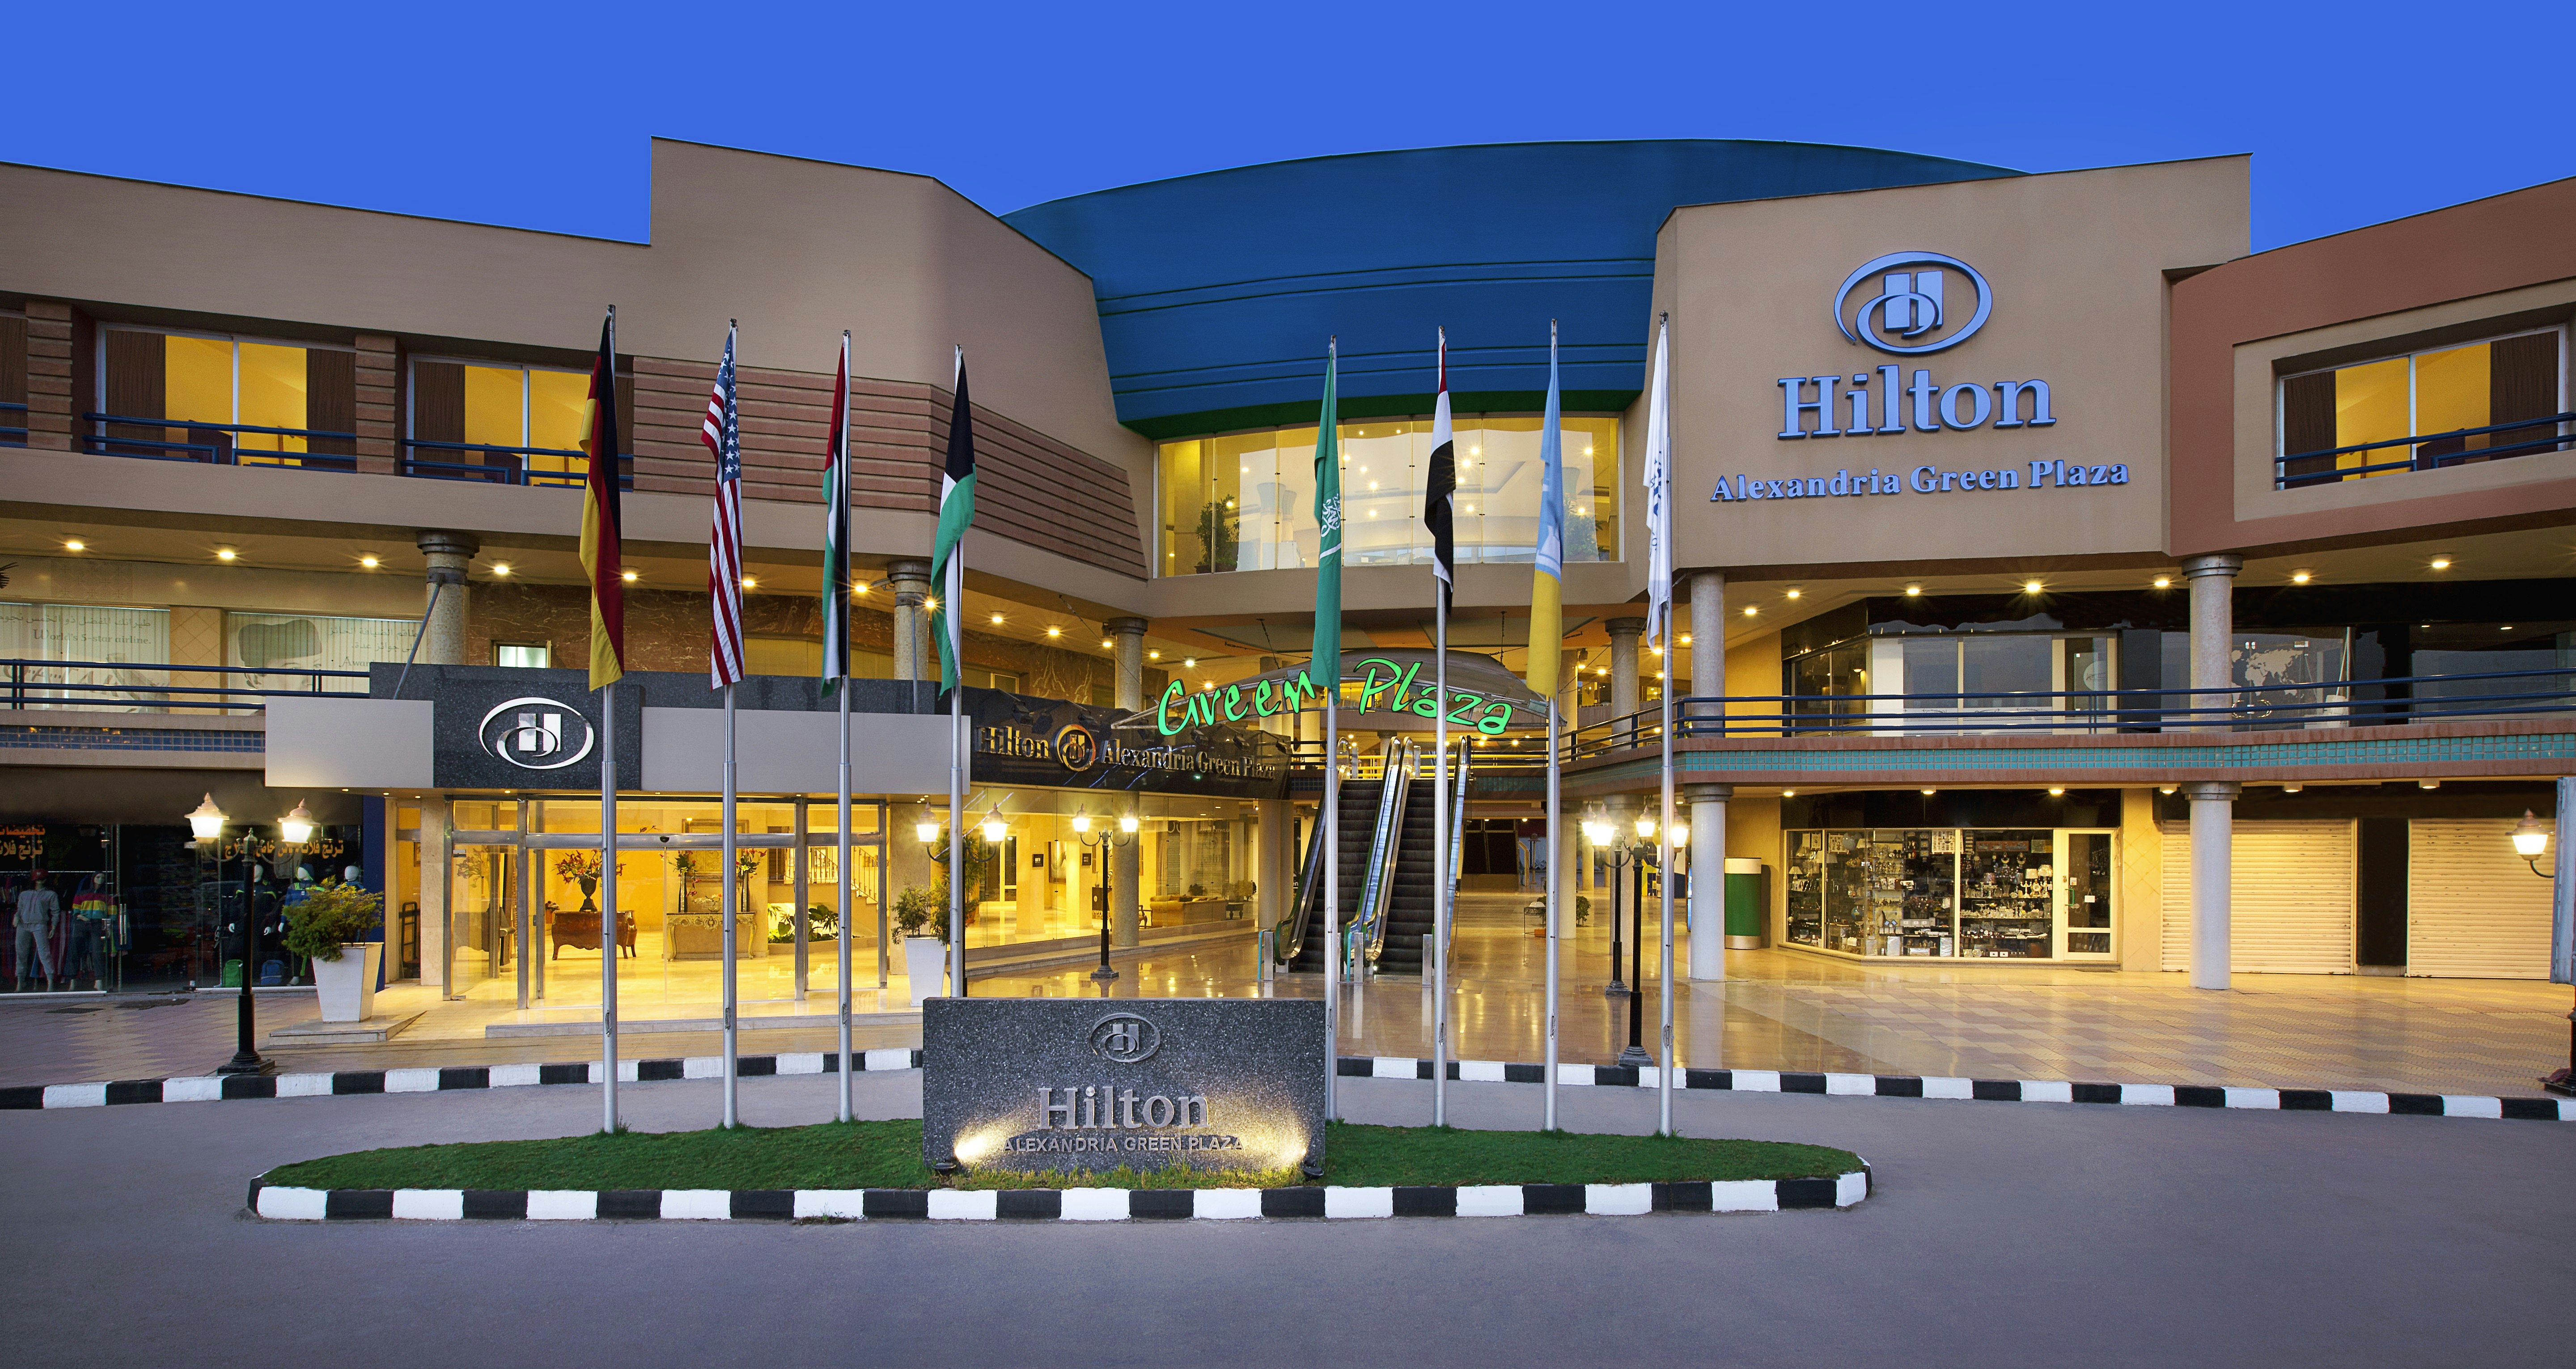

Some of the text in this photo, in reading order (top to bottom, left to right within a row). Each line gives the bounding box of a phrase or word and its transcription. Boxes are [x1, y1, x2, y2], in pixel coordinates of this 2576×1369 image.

[1777, 365, 2056, 440] Hilton
[1710, 459, 2130, 502] Alexandria Green Plaza
[1157, 657, 1515, 736] Green Plaza
[975, 726, 1050, 759] Hilton
[1100, 738, 1194, 772] Alexandria
[1196, 751, 1240, 776] Green
[1241, 755, 1275, 780] Plaza
[1038, 1085, 1211, 1130] Hilton
[1003, 1136, 1245, 1153] ALEXANDRIA GREEN PLAZA
